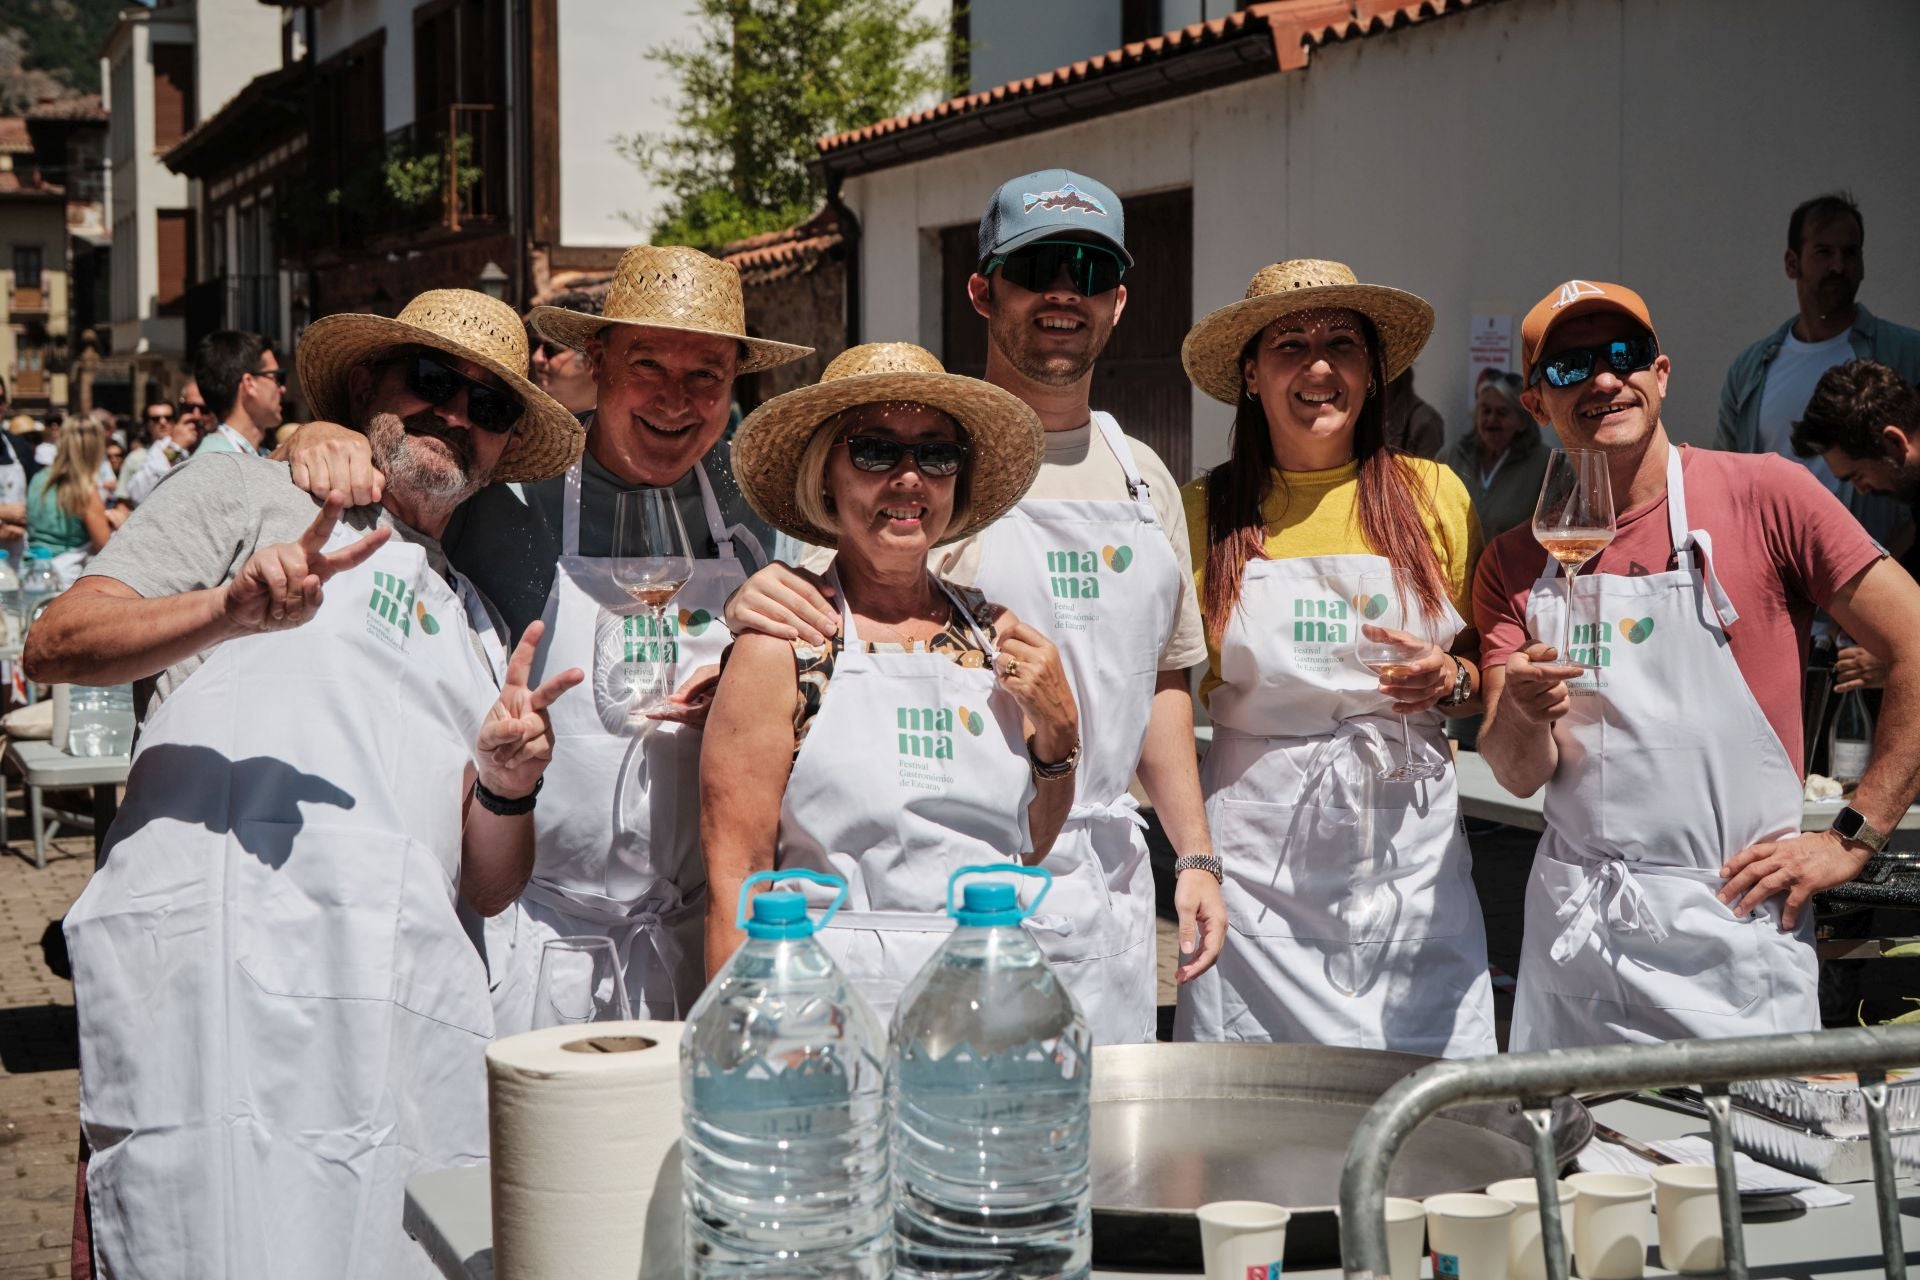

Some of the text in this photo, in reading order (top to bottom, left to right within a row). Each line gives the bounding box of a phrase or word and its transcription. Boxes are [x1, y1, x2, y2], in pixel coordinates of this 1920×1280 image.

[1046, 551, 1098, 573] ma
[374, 571, 414, 616] ma
[1051, 576, 1100, 599] ma
[369, 588, 410, 638] ma
[1294, 598, 1347, 619] ma
[624, 614, 678, 637] ma
[1294, 621, 1347, 643] ma
[1572, 621, 1612, 645] ma
[624, 641, 678, 663] ma
[1294, 646, 1321, 655] Festival
[1569, 646, 1611, 667] ma
[897, 707, 953, 733] ma
[898, 733, 954, 760] ma
[899, 760, 929, 771] Festival
